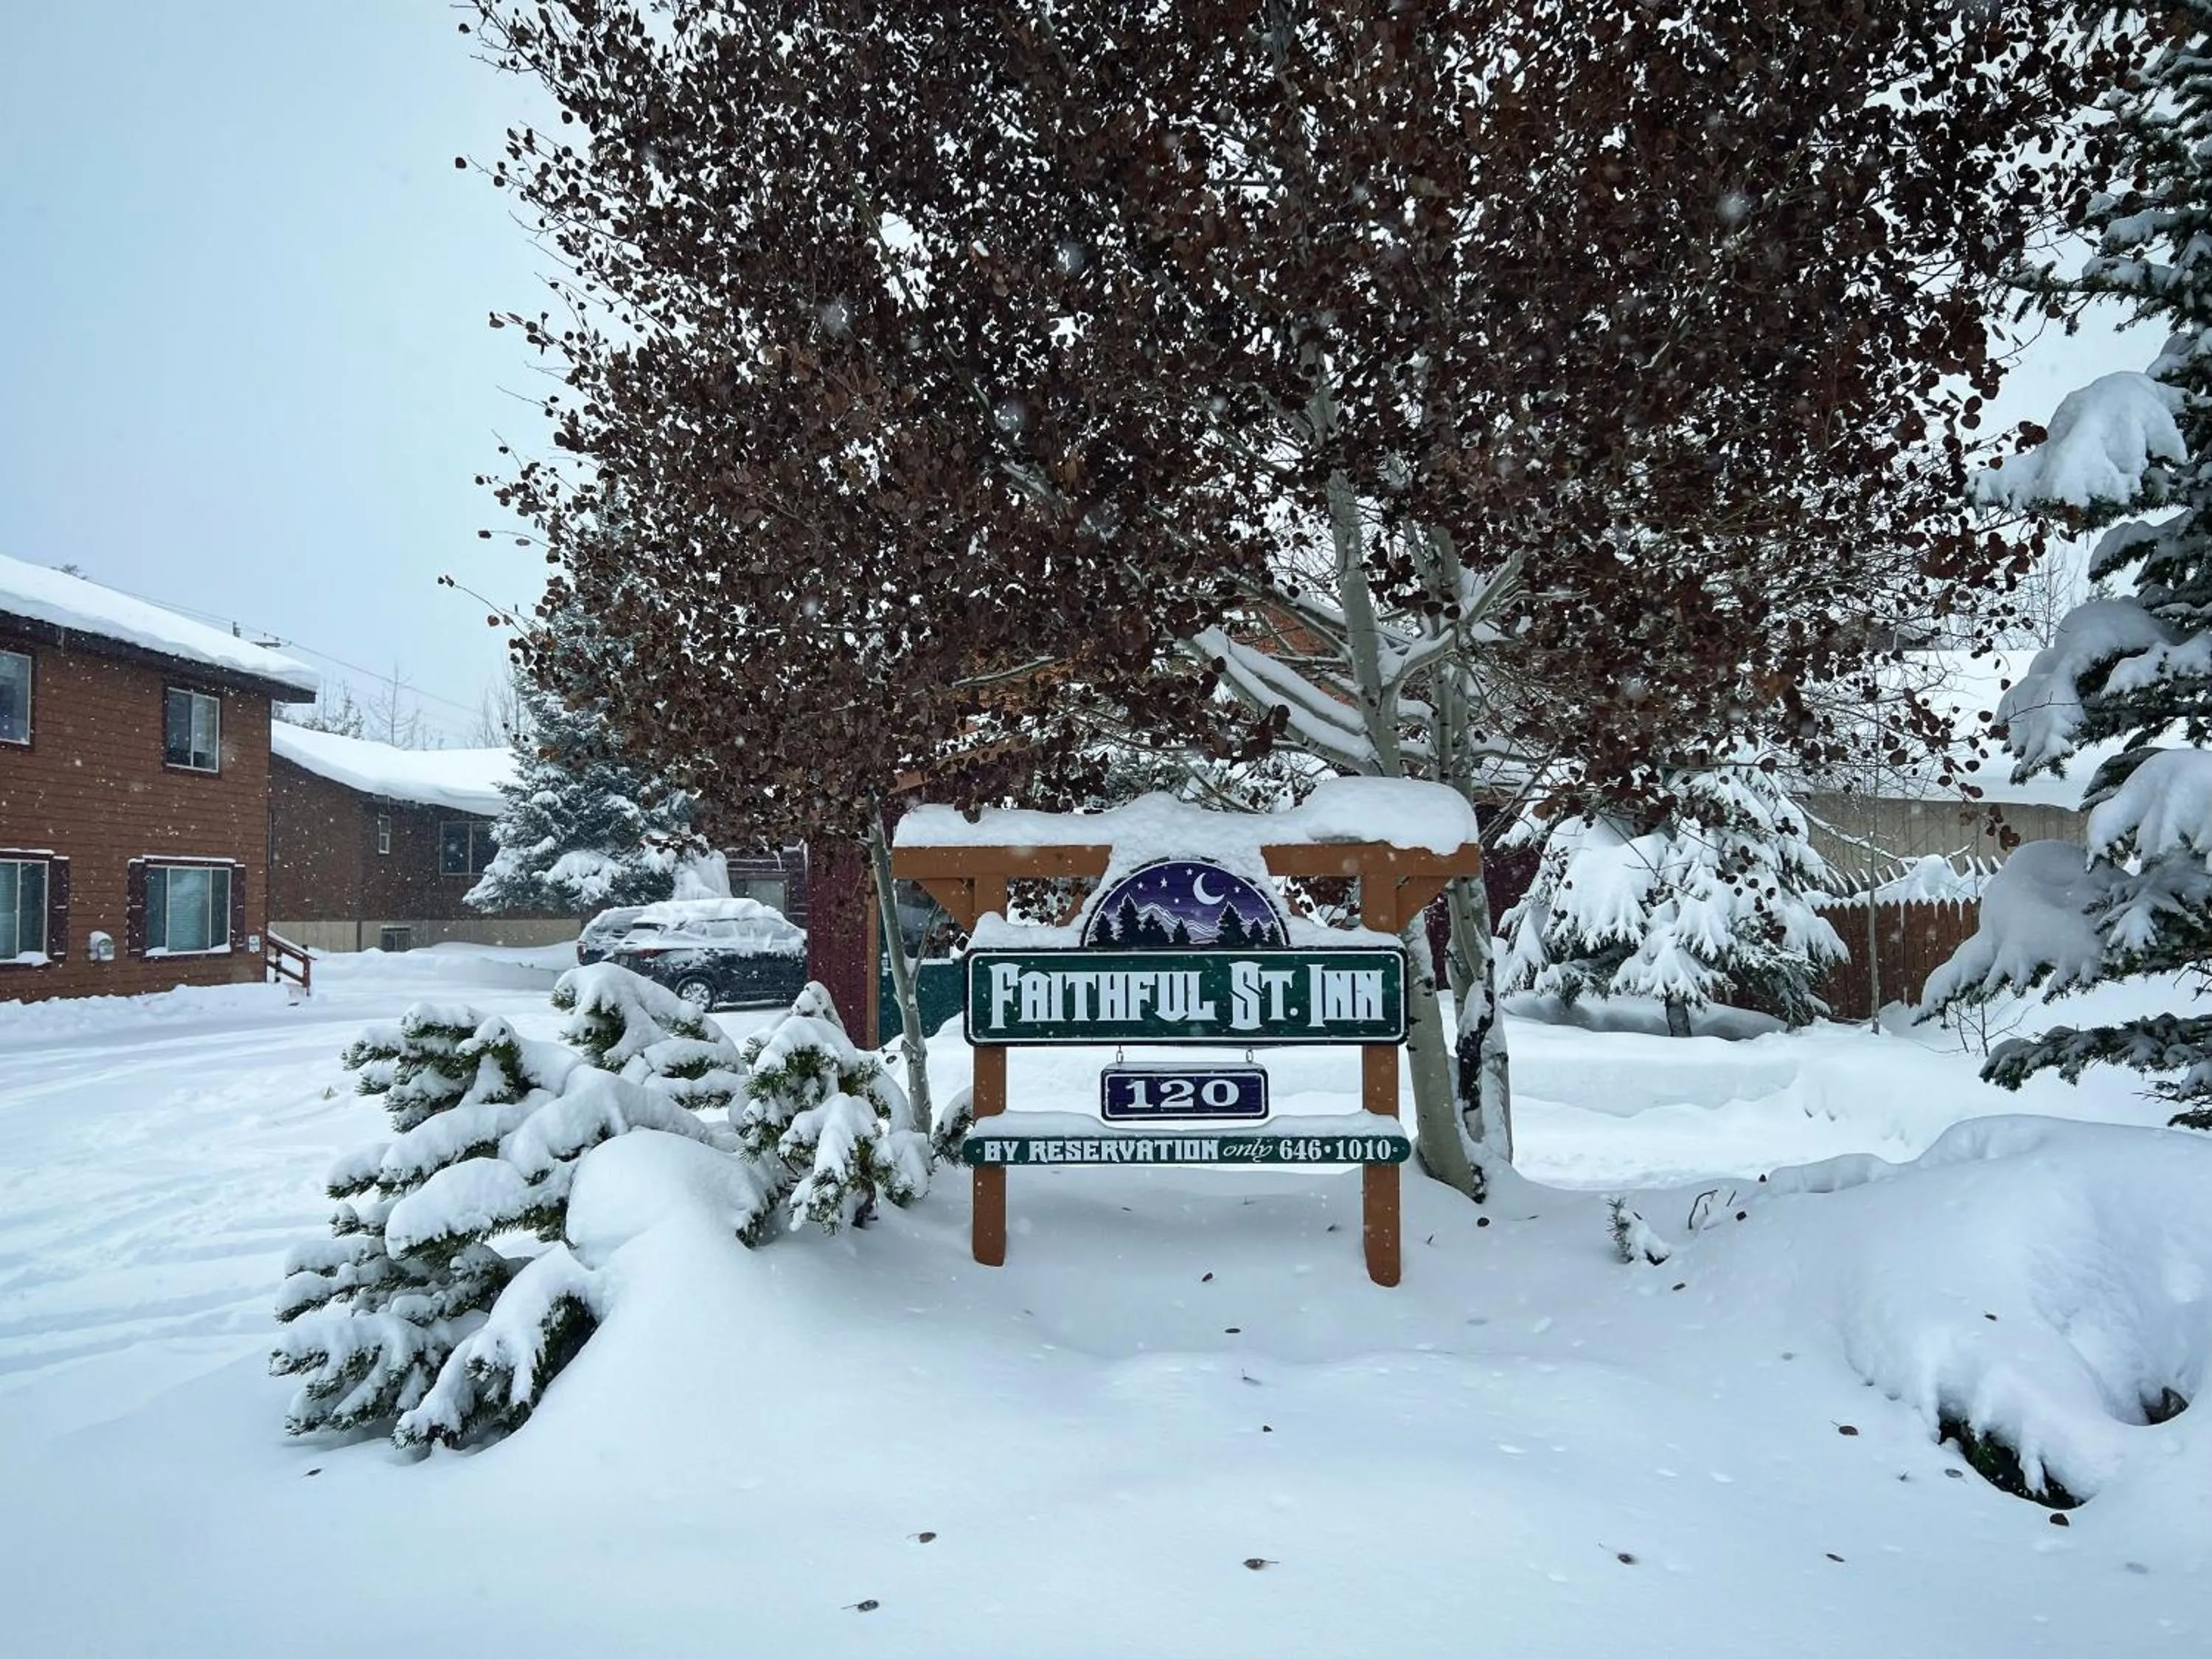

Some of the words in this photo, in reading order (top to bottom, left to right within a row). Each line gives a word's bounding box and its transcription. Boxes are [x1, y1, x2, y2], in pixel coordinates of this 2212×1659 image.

[989, 962, 1217, 1029] FAITHFUL
[1229, 961, 1298, 1029] ST.
[1307, 964, 1385, 1027] INN
[1127, 1079, 1239, 1107] 120
[984, 1141, 1020, 1161] BY
[1028, 1139, 1219, 1163] RESERVATION
[1222, 1138, 1273, 1163] only
